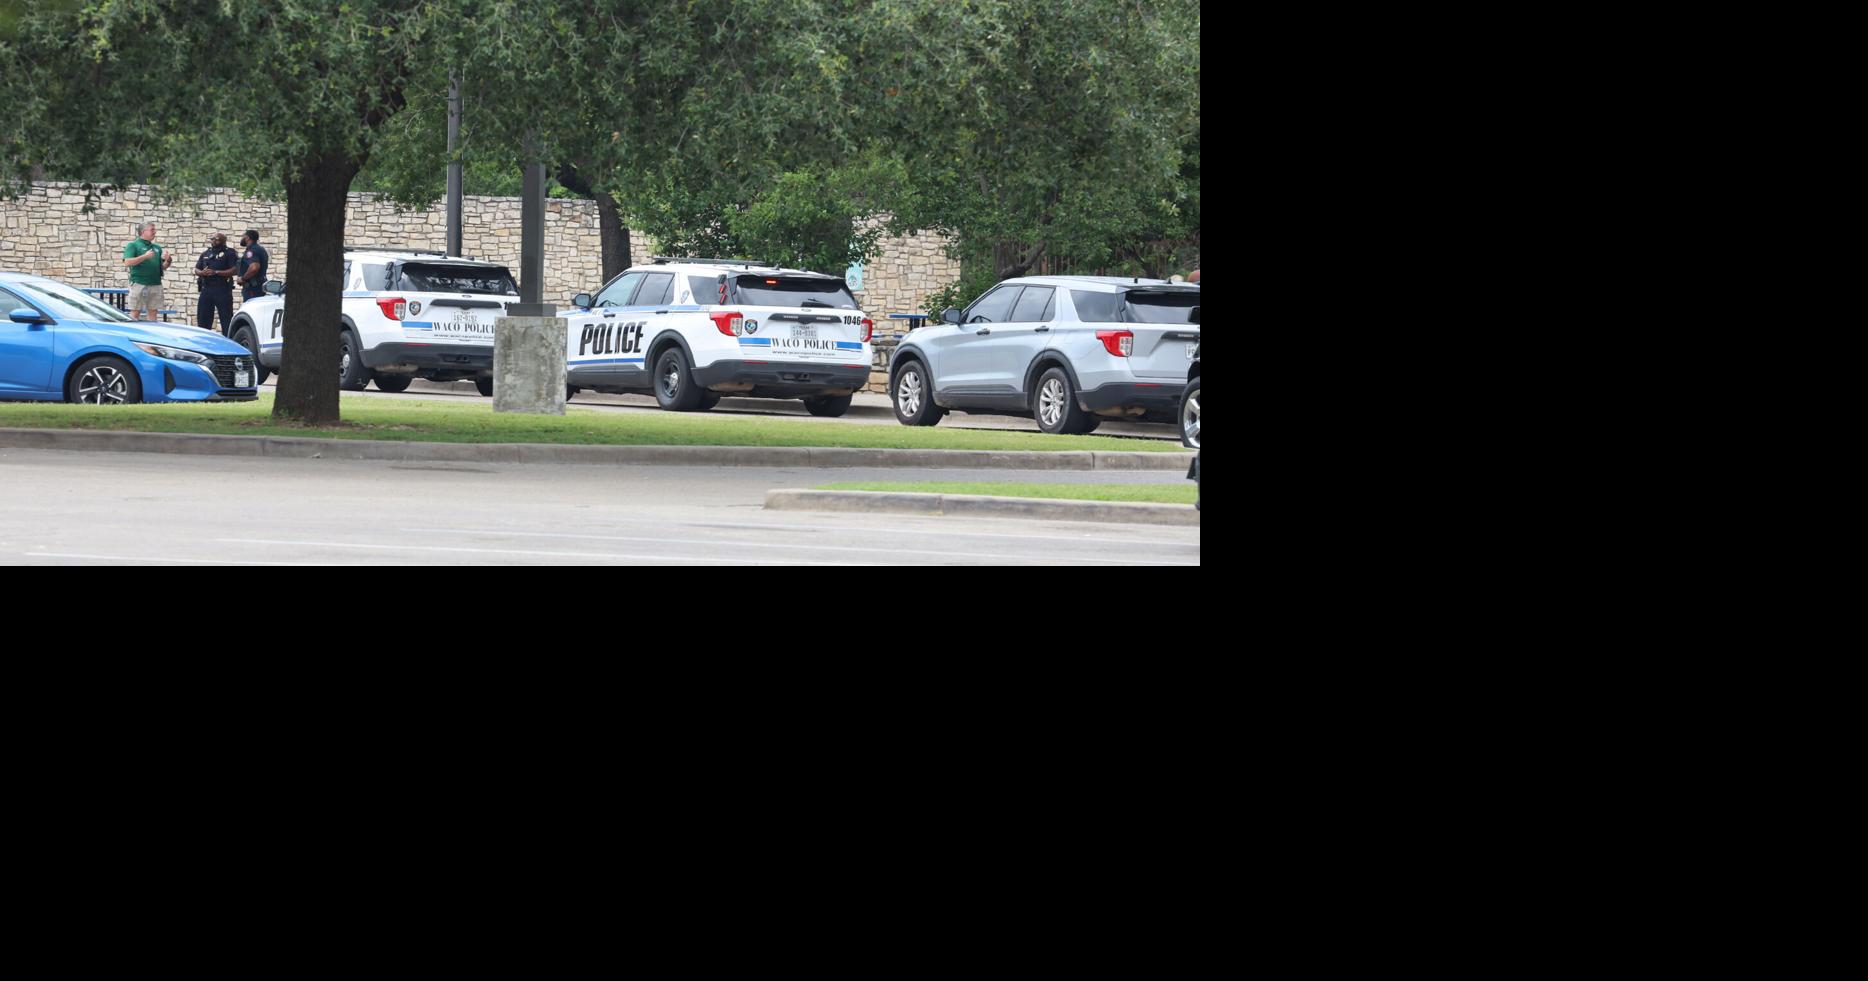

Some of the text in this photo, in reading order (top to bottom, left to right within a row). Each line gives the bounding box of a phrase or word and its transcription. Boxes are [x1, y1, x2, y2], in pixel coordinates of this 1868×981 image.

[433, 321, 460, 332] WACO
[843, 315, 861, 326] 1046
[579, 321, 647, 356] POLICE
[772, 338, 837, 351] WACO POLICE
